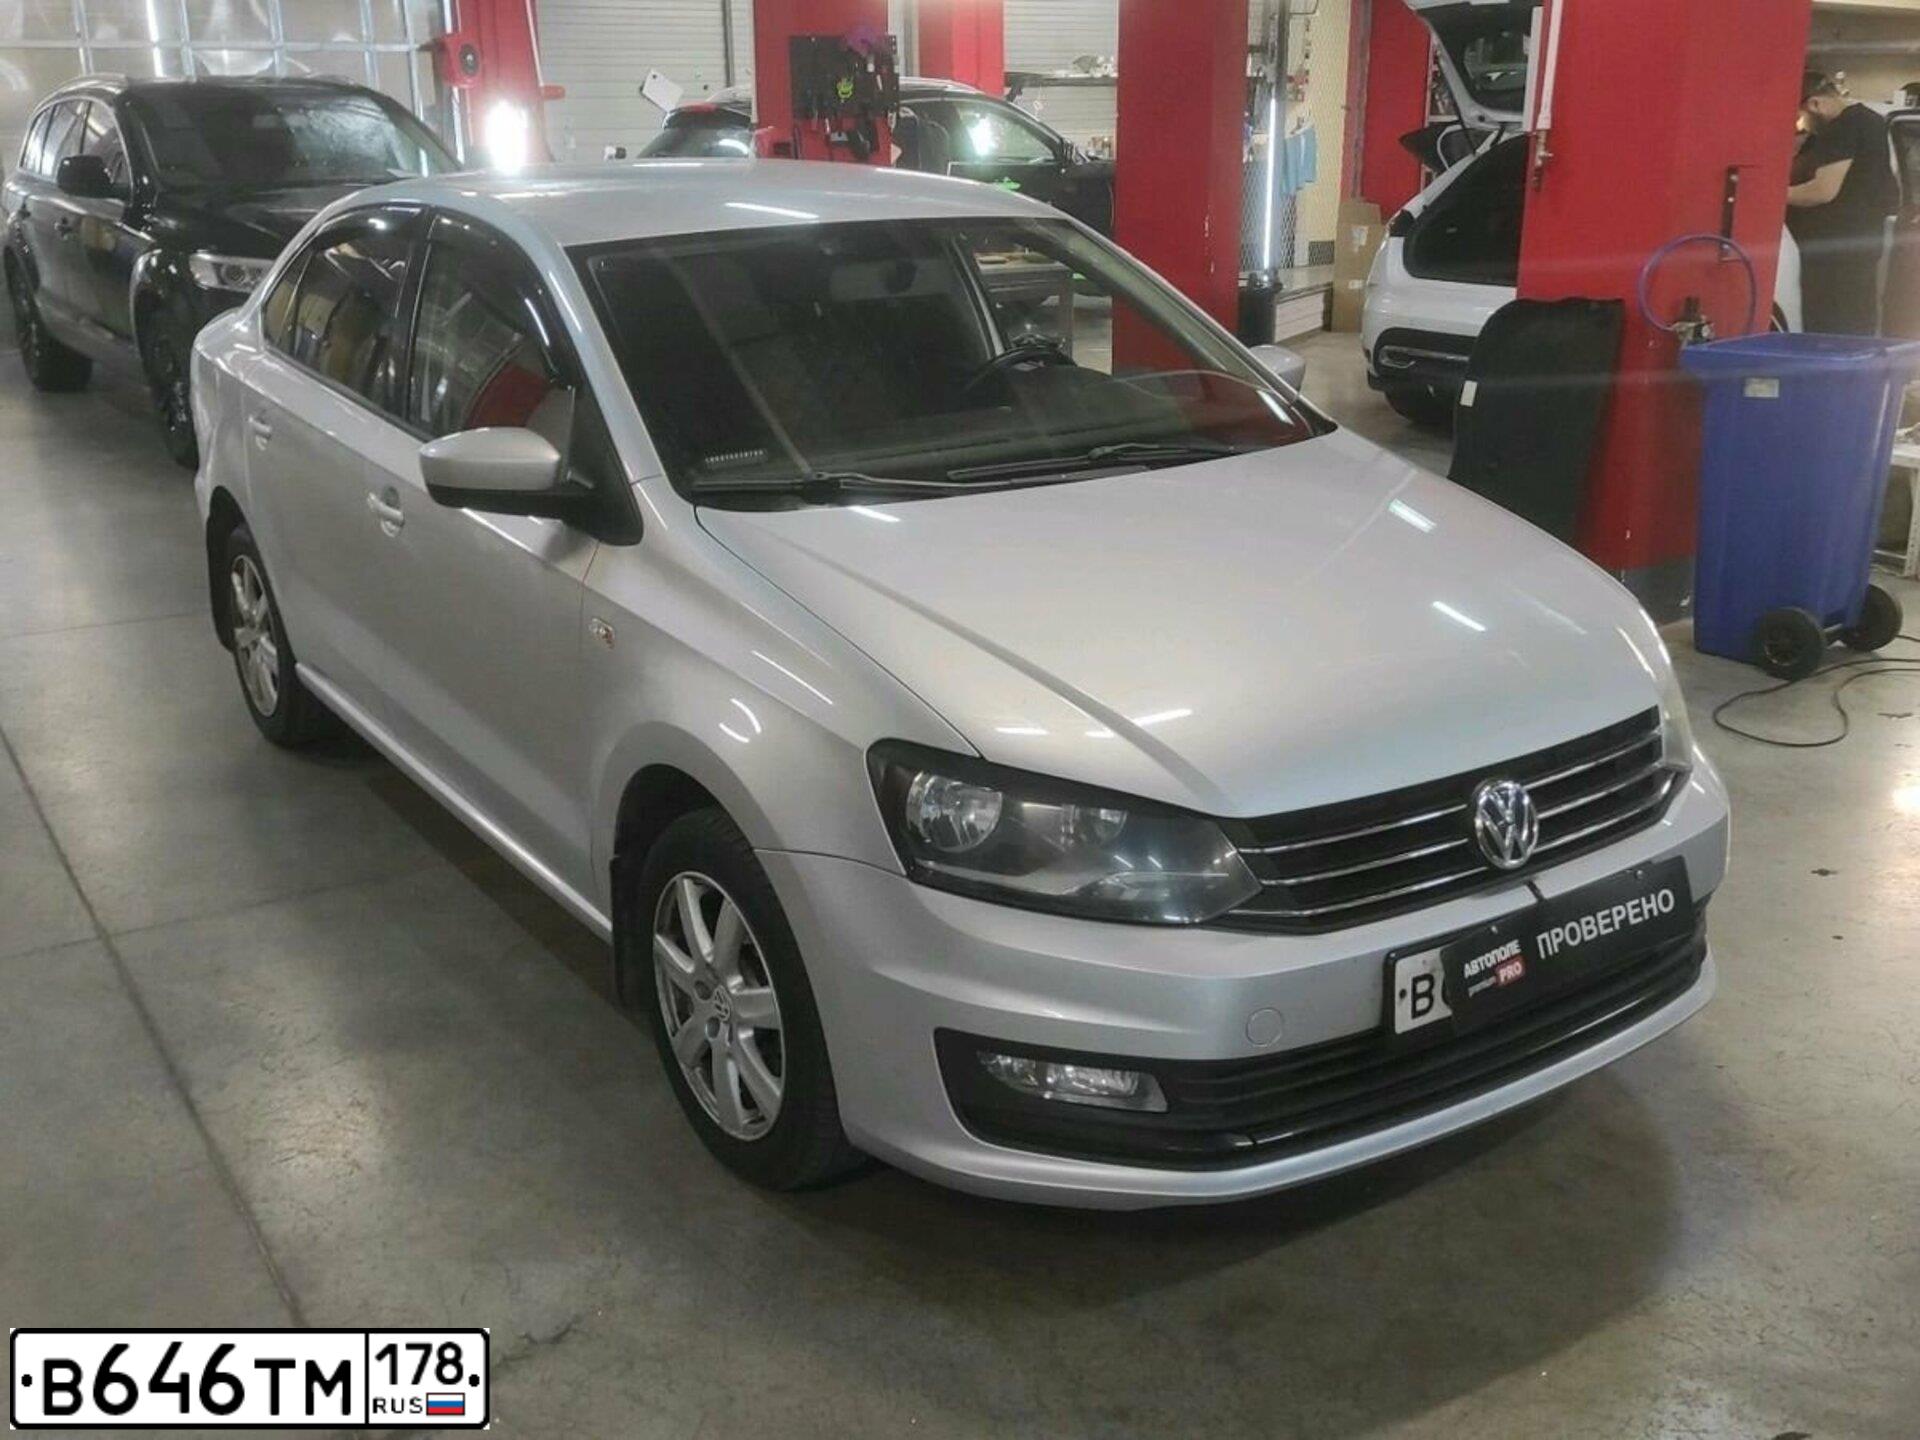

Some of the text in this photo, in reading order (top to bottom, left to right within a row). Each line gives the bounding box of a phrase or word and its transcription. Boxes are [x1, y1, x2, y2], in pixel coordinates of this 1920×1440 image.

[1536, 889, 1675, 960] ПРОВЕРЕНО
[1464, 939, 1522, 979] АВТОПОЛЕ
[1499, 961, 1523, 983] PRO
